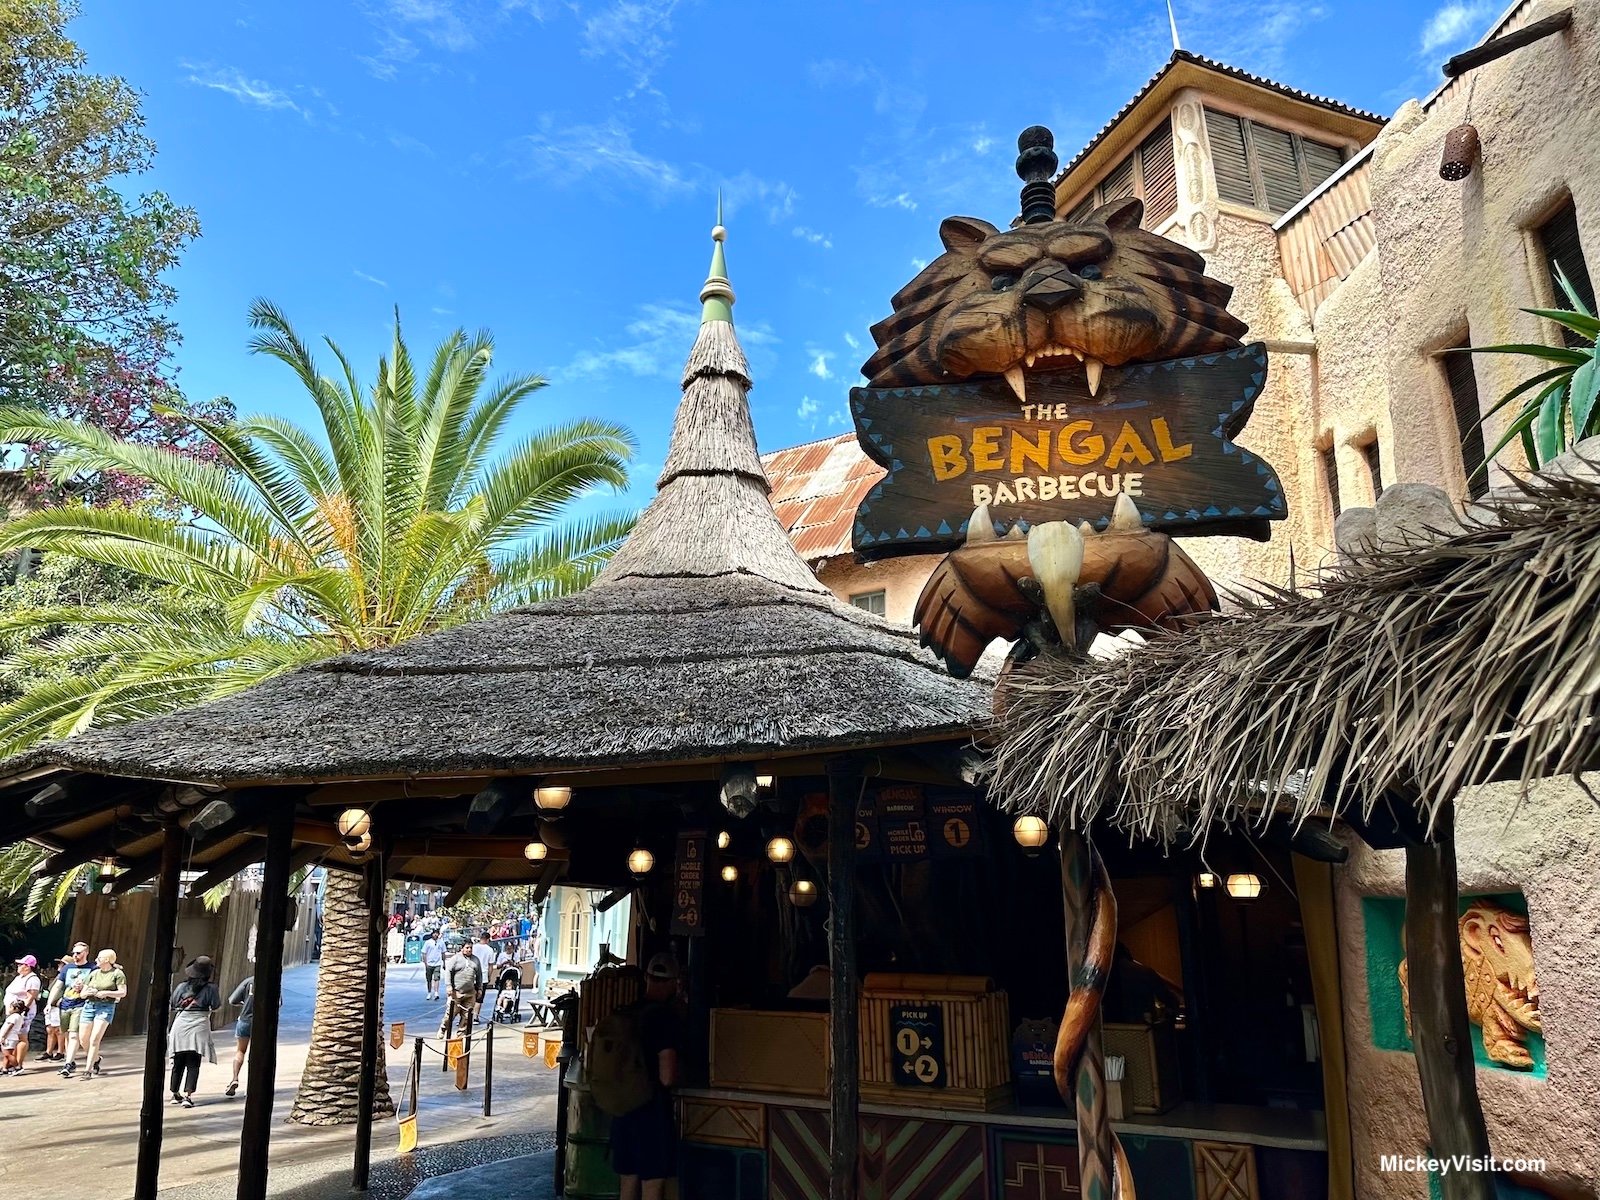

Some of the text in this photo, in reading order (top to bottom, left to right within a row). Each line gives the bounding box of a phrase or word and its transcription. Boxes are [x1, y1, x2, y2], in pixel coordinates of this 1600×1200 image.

[1021, 403, 1068, 422] THE
[927, 417, 1193, 482] BENGAL
[971, 471, 1145, 507] BARBECUE
[932, 805, 973, 814] WINDOW
[949, 821, 961, 844] 1
[890, 844, 926, 855] PICK UP
[680, 862, 701, 871] MOBILE
[680, 872, 700, 880] ORDER
[679, 880, 691, 889] PICK
[901, 1011, 928, 1020] PICK UP
[903, 1033, 911, 1050] 1
[920, 1059, 933, 1077] 2
